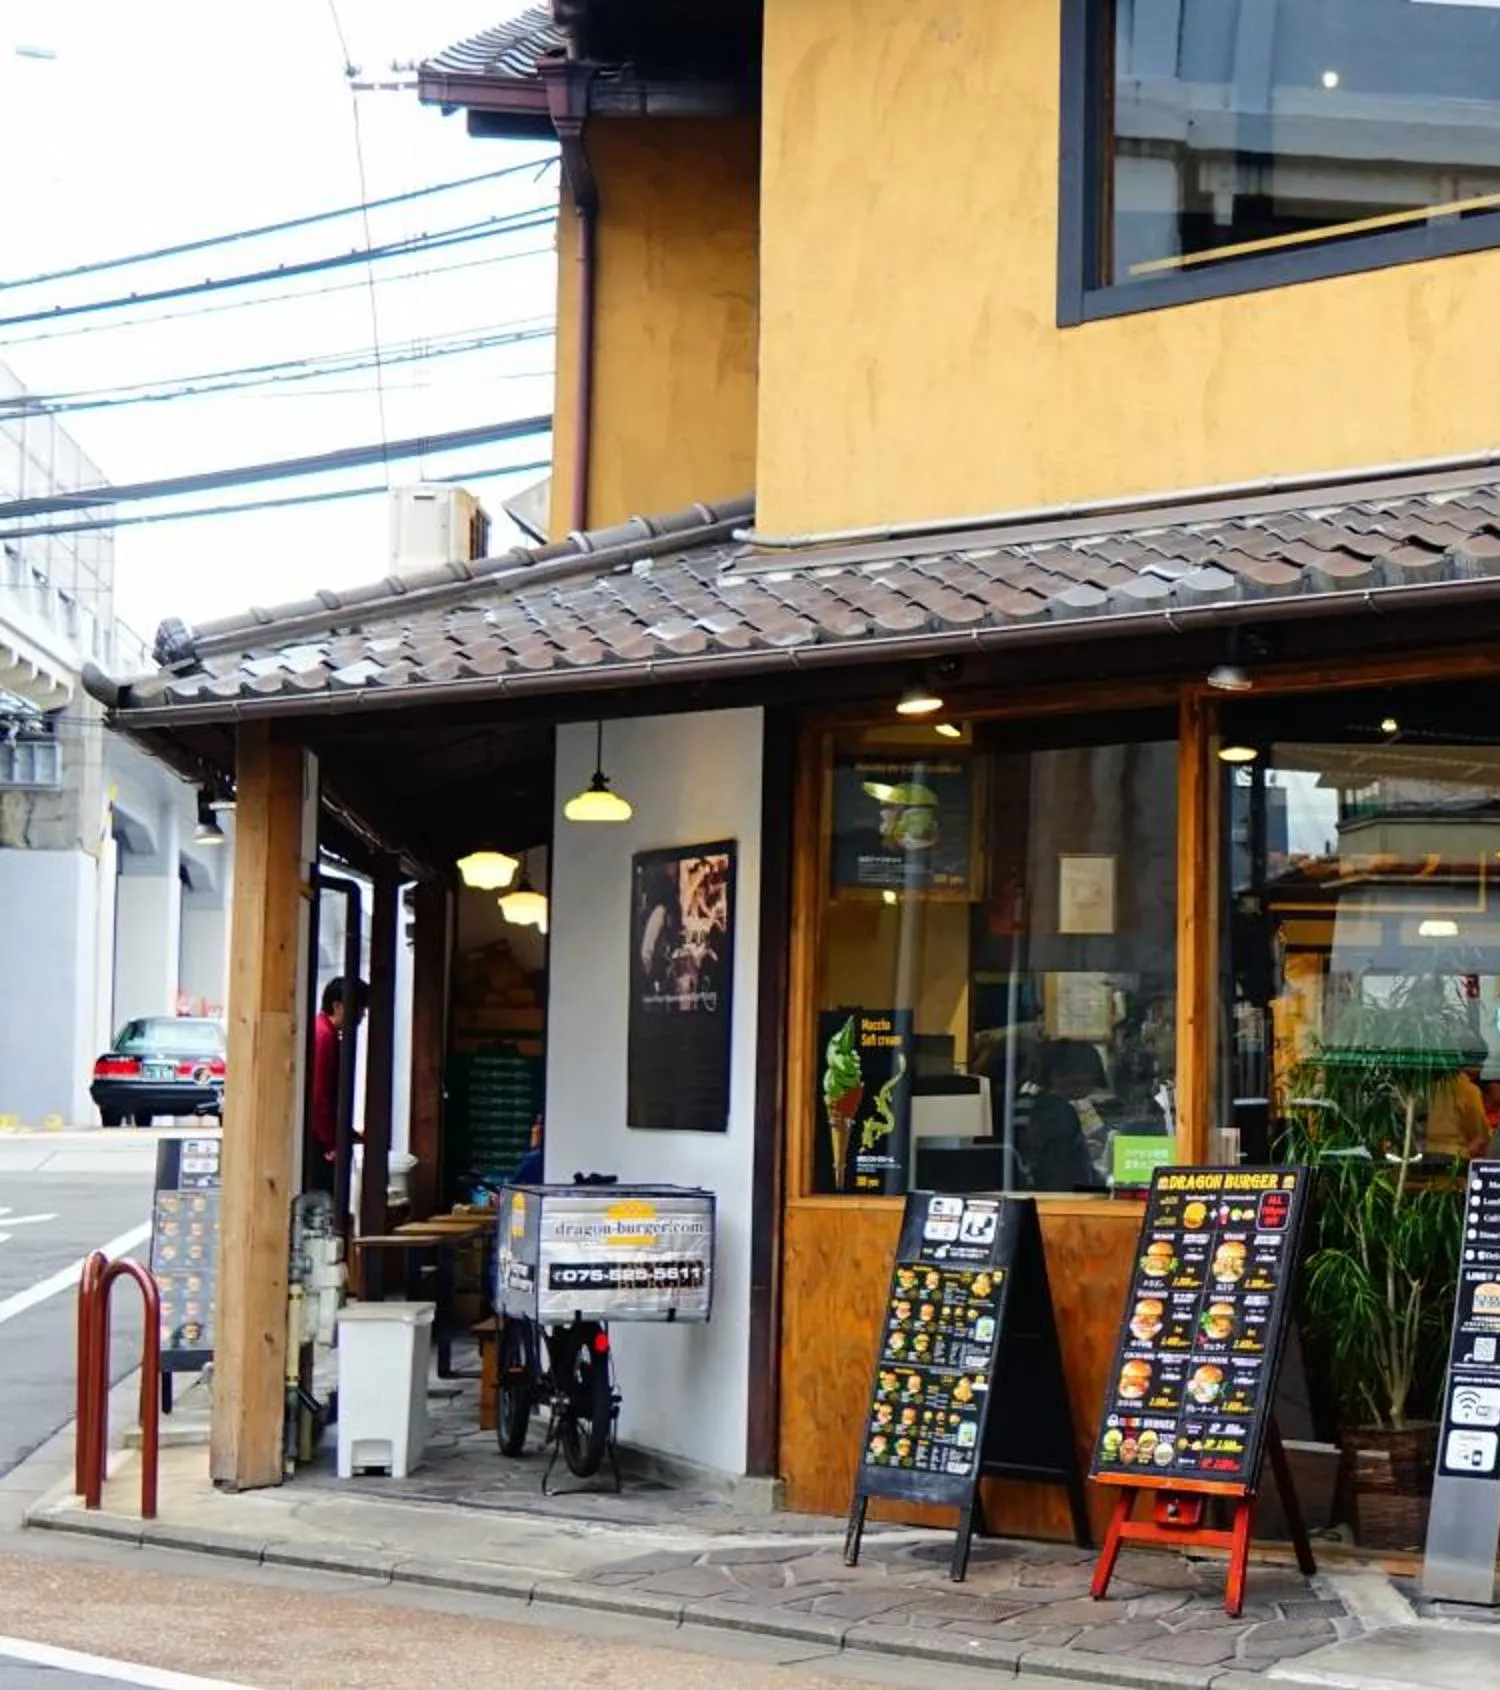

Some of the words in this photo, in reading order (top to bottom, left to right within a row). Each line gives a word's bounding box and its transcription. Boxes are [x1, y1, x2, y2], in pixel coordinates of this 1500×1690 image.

[1168, 1174, 1223, 1189] DRAGON
[1223, 1173, 1279, 1189] BURGER
[554, 1221, 704, 1238] dragon-burger.com
